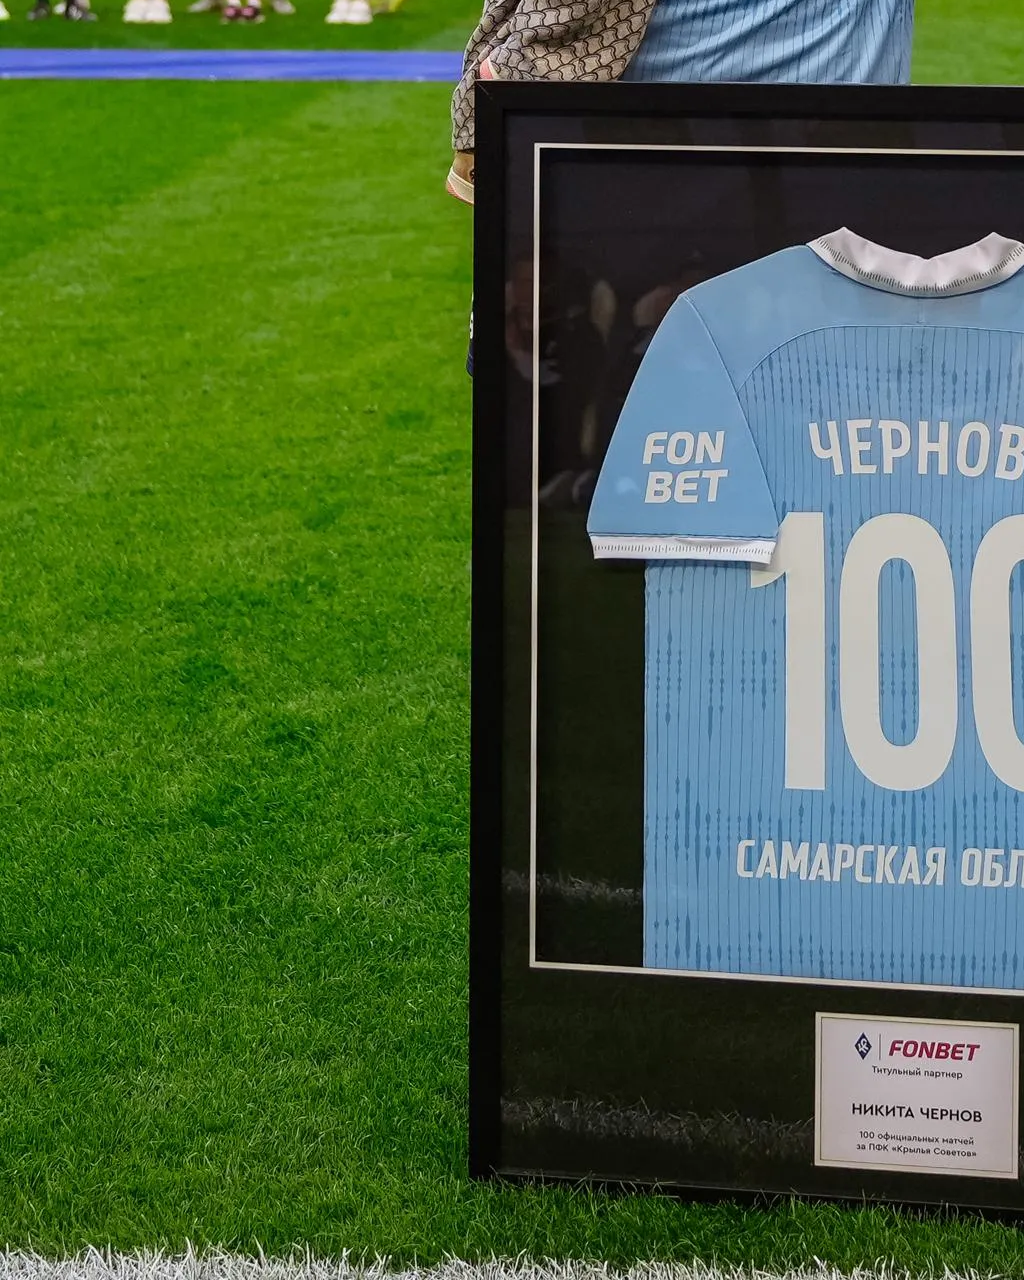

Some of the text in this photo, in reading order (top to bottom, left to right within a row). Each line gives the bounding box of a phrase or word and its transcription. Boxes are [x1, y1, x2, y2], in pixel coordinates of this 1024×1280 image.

[642, 430, 725, 465] FON
[644, 469, 729, 504] BET
[736, 839, 946, 886] САМАРСКАЯ
[888, 1039, 981, 1061] FONBET
[872, 1065, 963, 1080] Титульный партнер
[852, 1103, 983, 1123] НИКИТА ЧЕРНОВ
[859, 1130, 975, 1146] 100 официальных матчей
[868, 1143, 889, 1152] ПФК
[891, 1145, 931, 1155] «Крылья
[933, 1147, 977, 1157] Советов»
